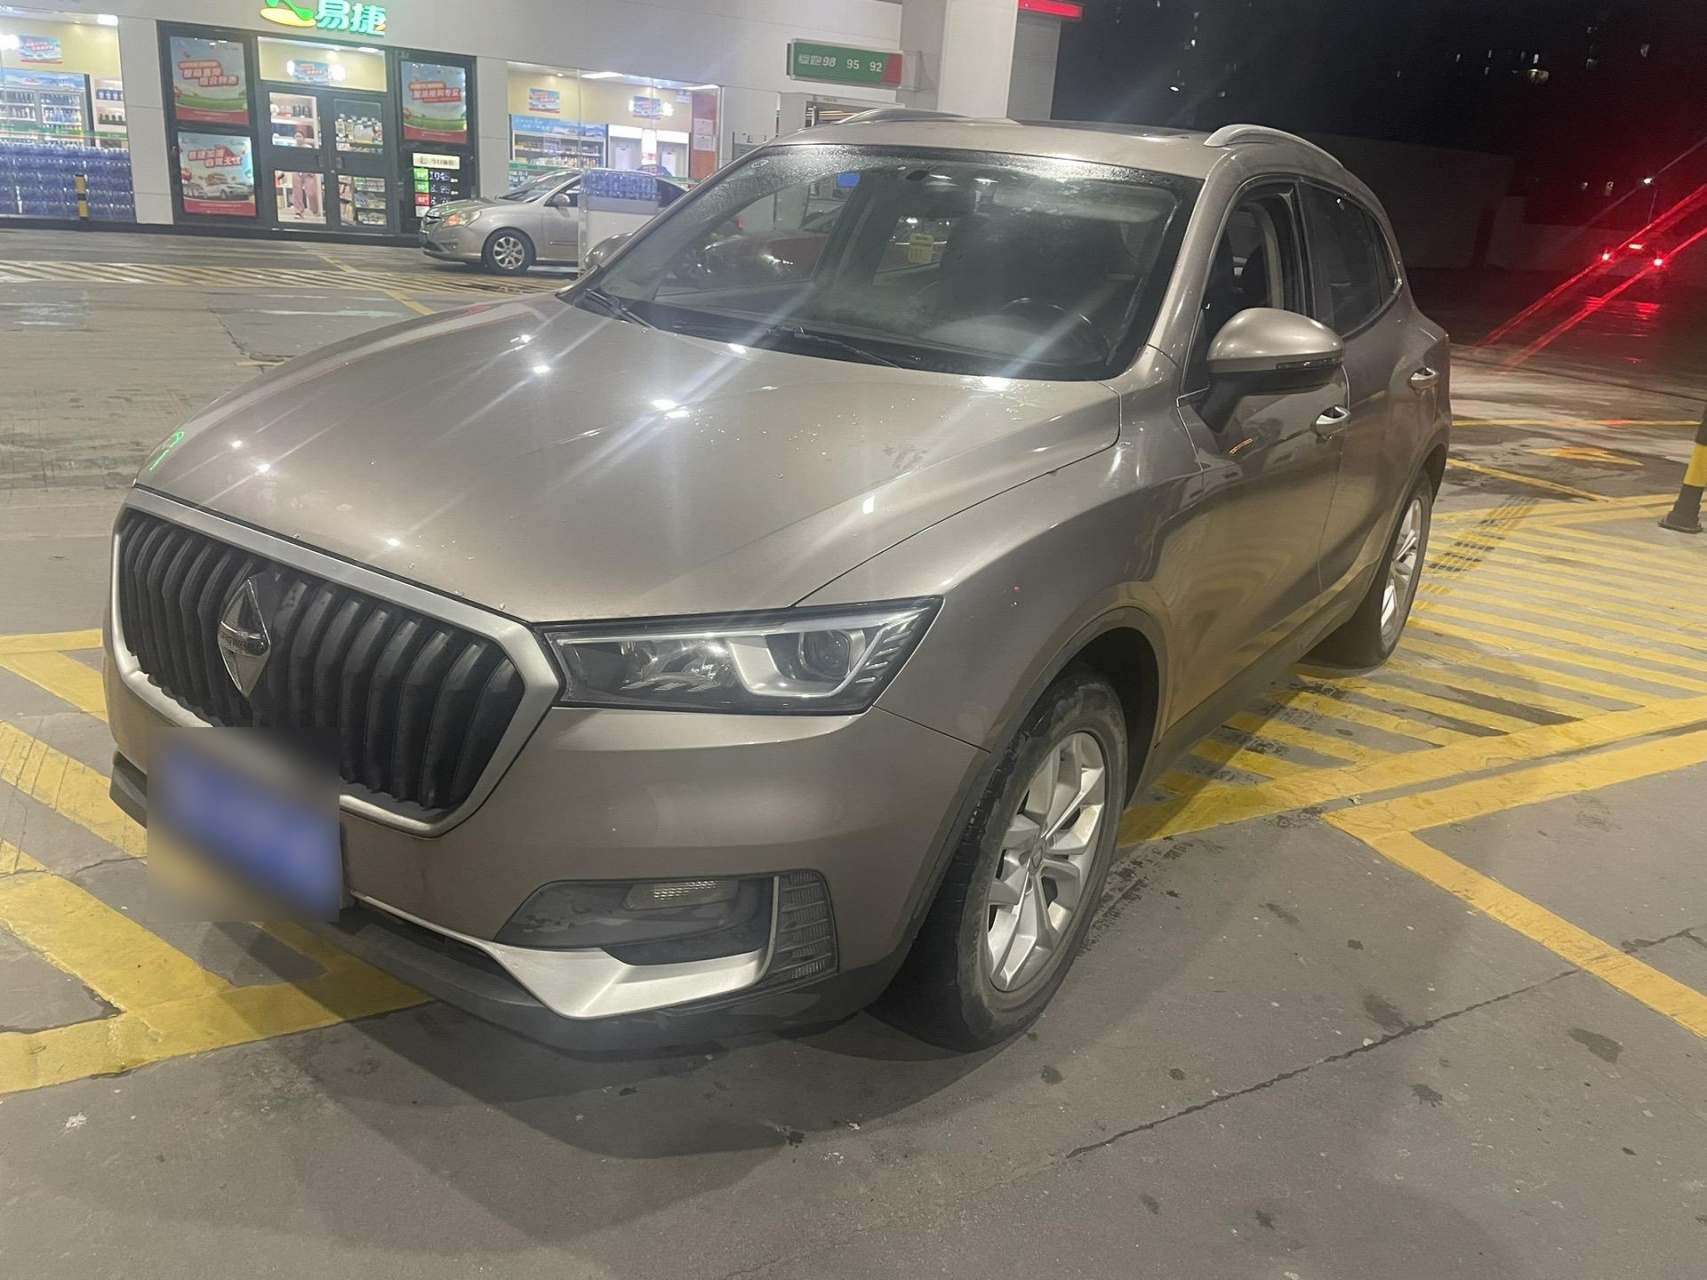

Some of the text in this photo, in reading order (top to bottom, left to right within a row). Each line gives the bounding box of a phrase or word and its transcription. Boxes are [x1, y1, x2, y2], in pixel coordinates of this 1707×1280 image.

[315, 0, 387, 36] 易捷
[846, 58, 860, 70] 95
[869, 61, 883, 73] 92
